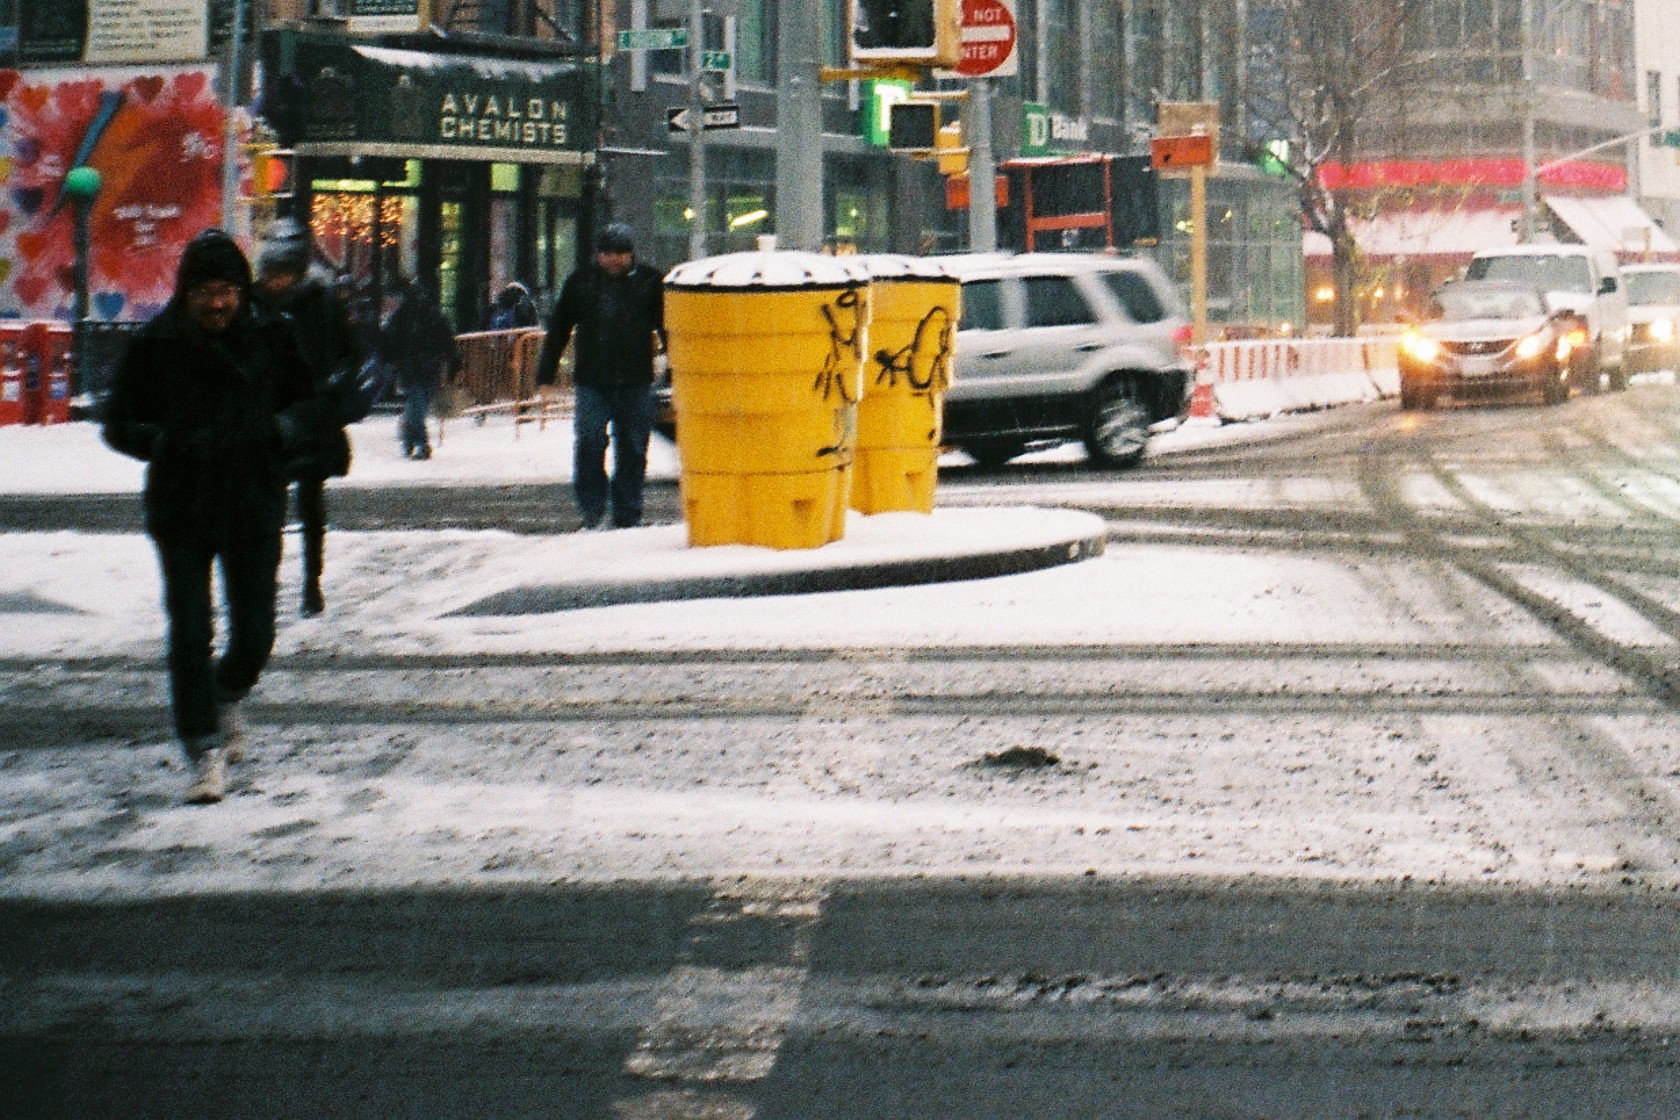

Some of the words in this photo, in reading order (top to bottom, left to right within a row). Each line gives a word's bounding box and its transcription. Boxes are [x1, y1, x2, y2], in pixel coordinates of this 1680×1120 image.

[973, 7, 1002, 22] NOT
[961, 44, 998, 60] NTER
[441, 93, 567, 120] AVALON
[439, 116, 567, 145] CHEMISTS
[1025, 112, 1047, 147] TD
[1051, 114, 1088, 142] Bank
